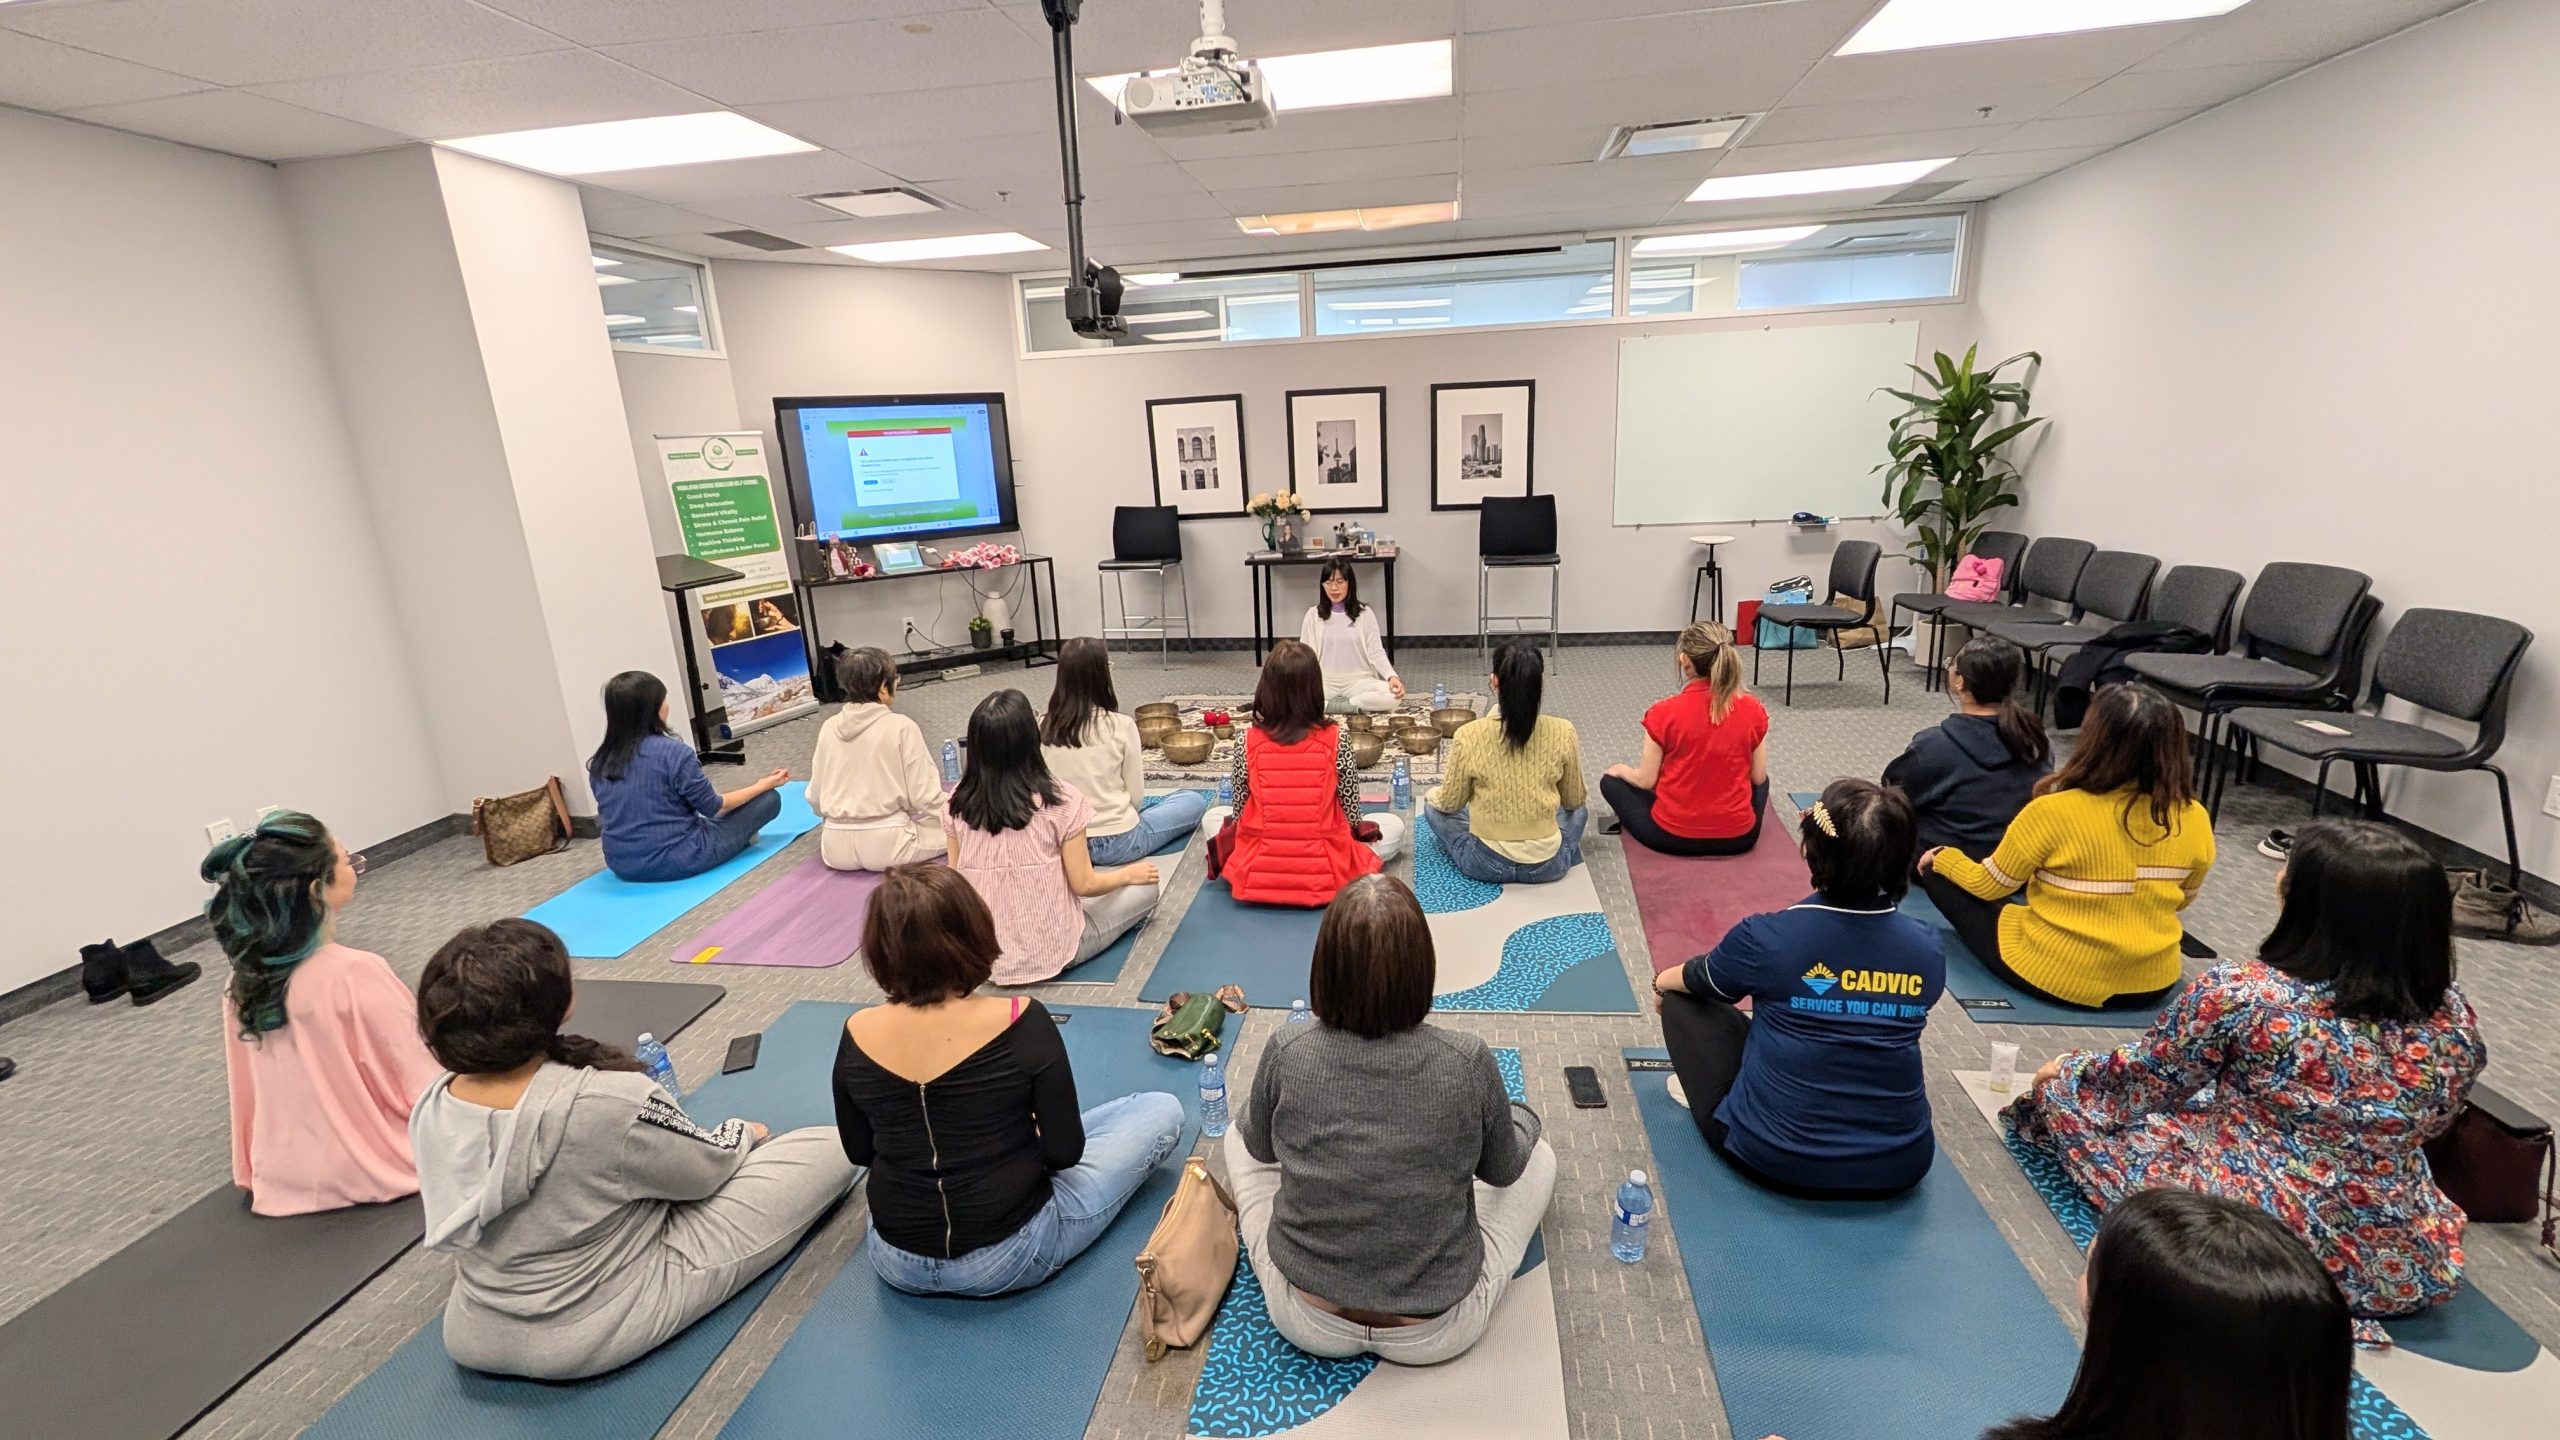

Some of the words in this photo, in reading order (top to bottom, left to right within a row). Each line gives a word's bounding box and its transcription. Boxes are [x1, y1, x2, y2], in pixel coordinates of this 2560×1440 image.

[701, 547, 735, 555] Mindfulness
[1841, 969, 1923, 996] CADVIC
[1790, 996, 1842, 1013] SERVICE
[1846, 1000, 1868, 1014] YOU
[1872, 1002, 1897, 1016] CAN
[1900, 1004, 1929, 1018] TRUS
